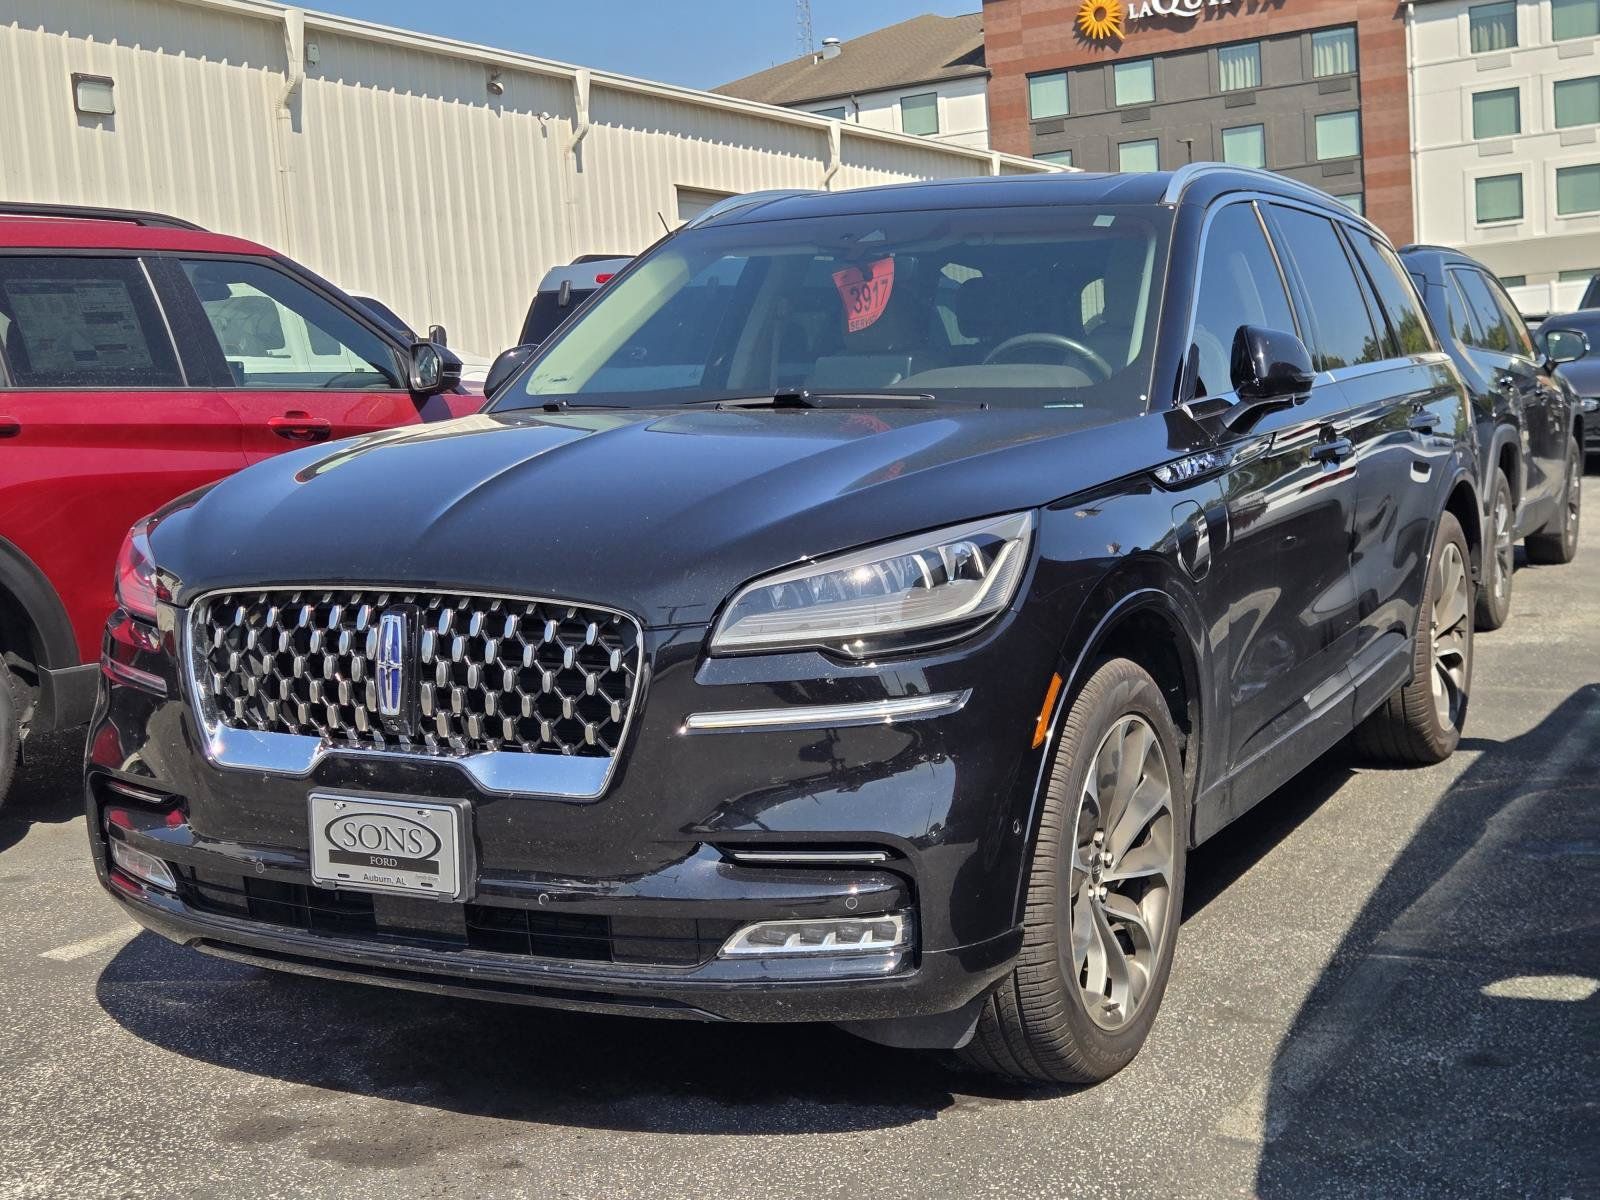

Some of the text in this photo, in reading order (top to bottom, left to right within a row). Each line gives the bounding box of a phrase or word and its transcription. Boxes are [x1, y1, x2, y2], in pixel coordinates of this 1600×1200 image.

[1128, 1, 1153, 19] LA
[849, 279, 889, 313] 3917
[343, 822, 423, 854] SONS
[369, 855, 398, 868] FORD
[363, 873, 394, 885] Auburn,
[396, 876, 407, 886] AL
